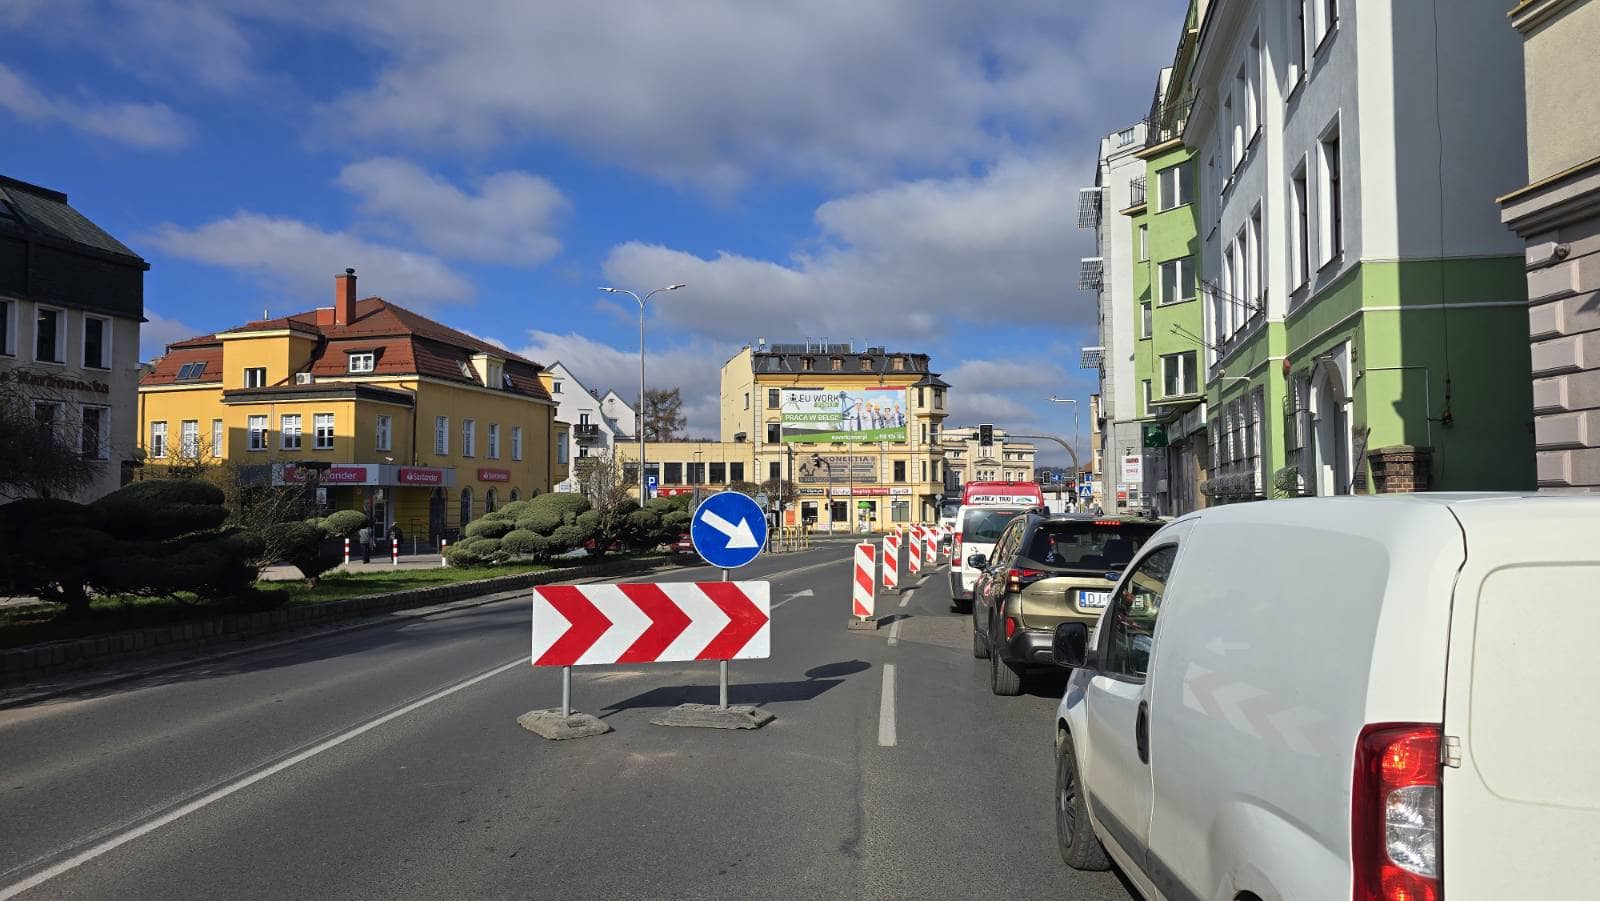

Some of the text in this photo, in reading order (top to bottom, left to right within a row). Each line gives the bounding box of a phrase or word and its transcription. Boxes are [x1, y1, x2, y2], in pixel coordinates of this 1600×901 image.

[799, 394, 840, 403] EU WORK
[648, 476, 656, 487] P
